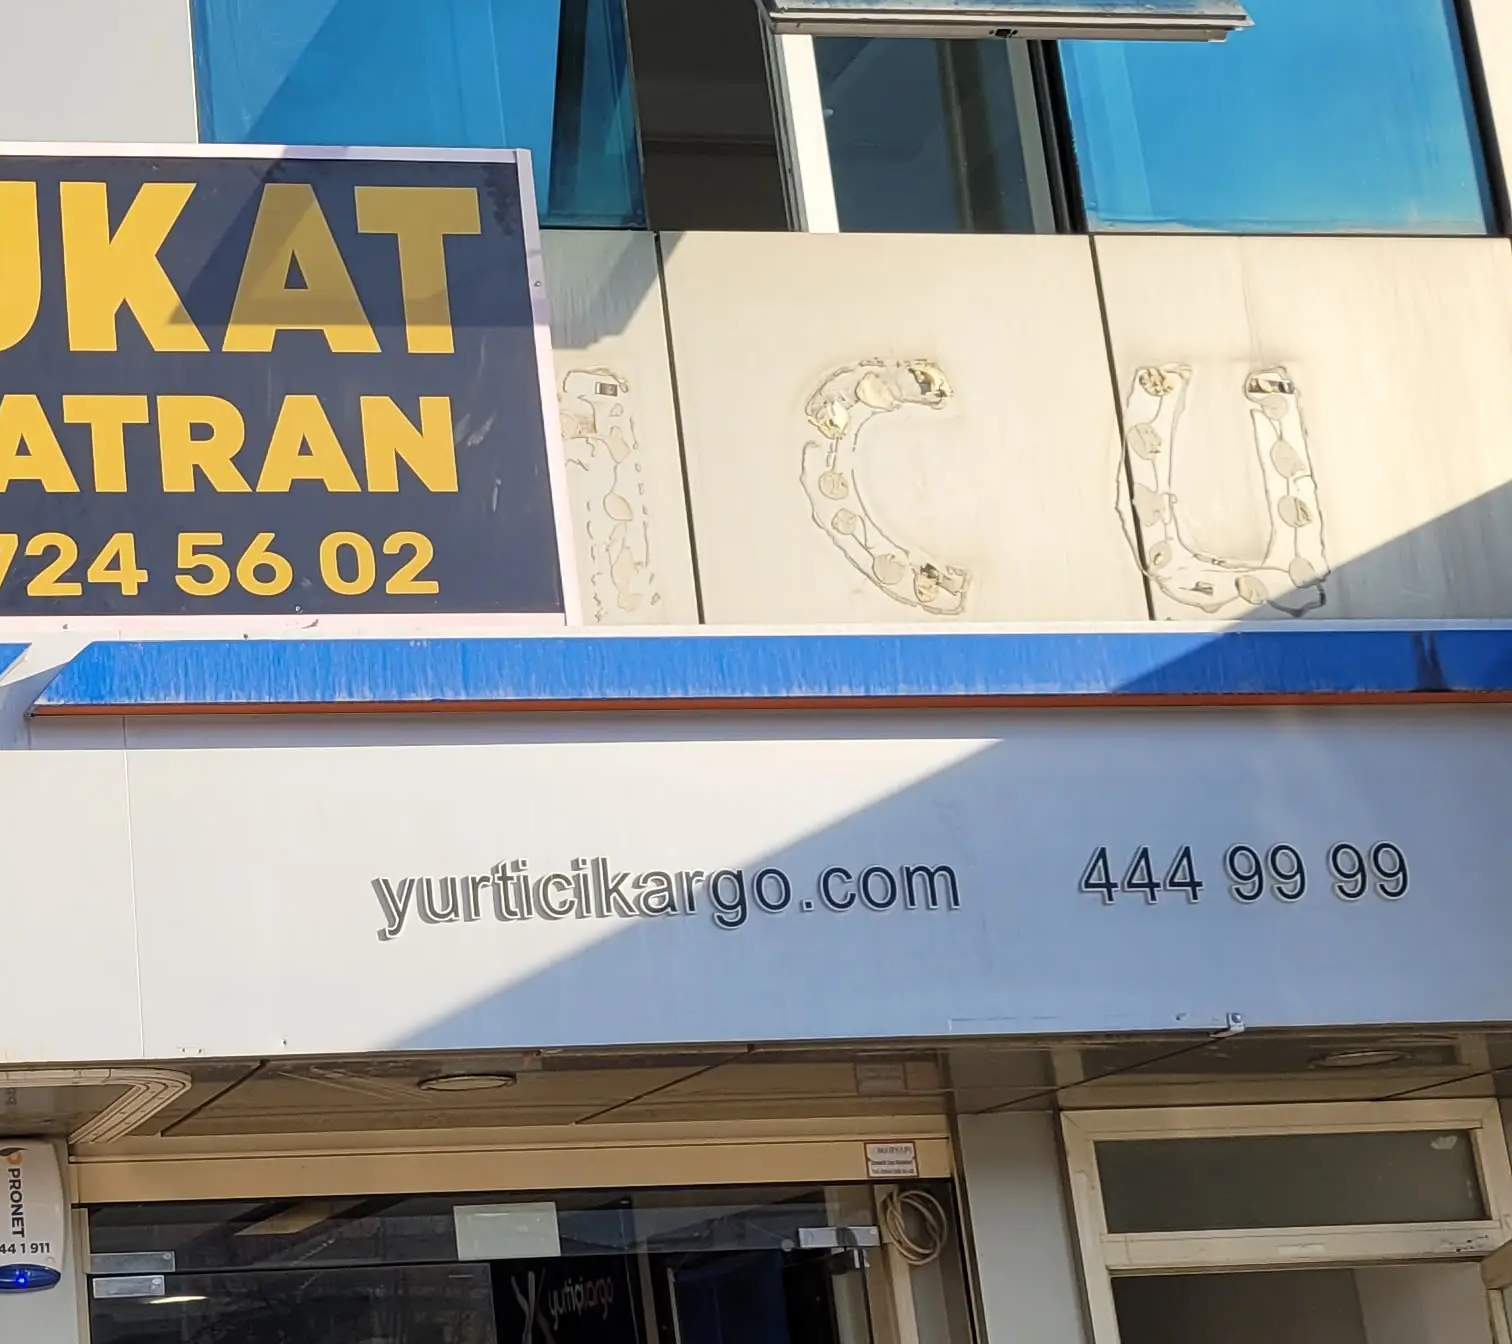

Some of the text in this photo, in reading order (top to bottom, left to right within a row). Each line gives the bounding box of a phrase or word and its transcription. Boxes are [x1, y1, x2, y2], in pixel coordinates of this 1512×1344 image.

[175, 531, 294, 597] 56
[318, 530, 440, 596] 02
[370, 856, 962, 942] yurticikargo.com
[1079, 840, 1410, 905] 444 99 99
[7, 1167, 26, 1239] PRONET
[20, 1243, 27, 1254] 1
[30, 1242, 51, 1254] 911
